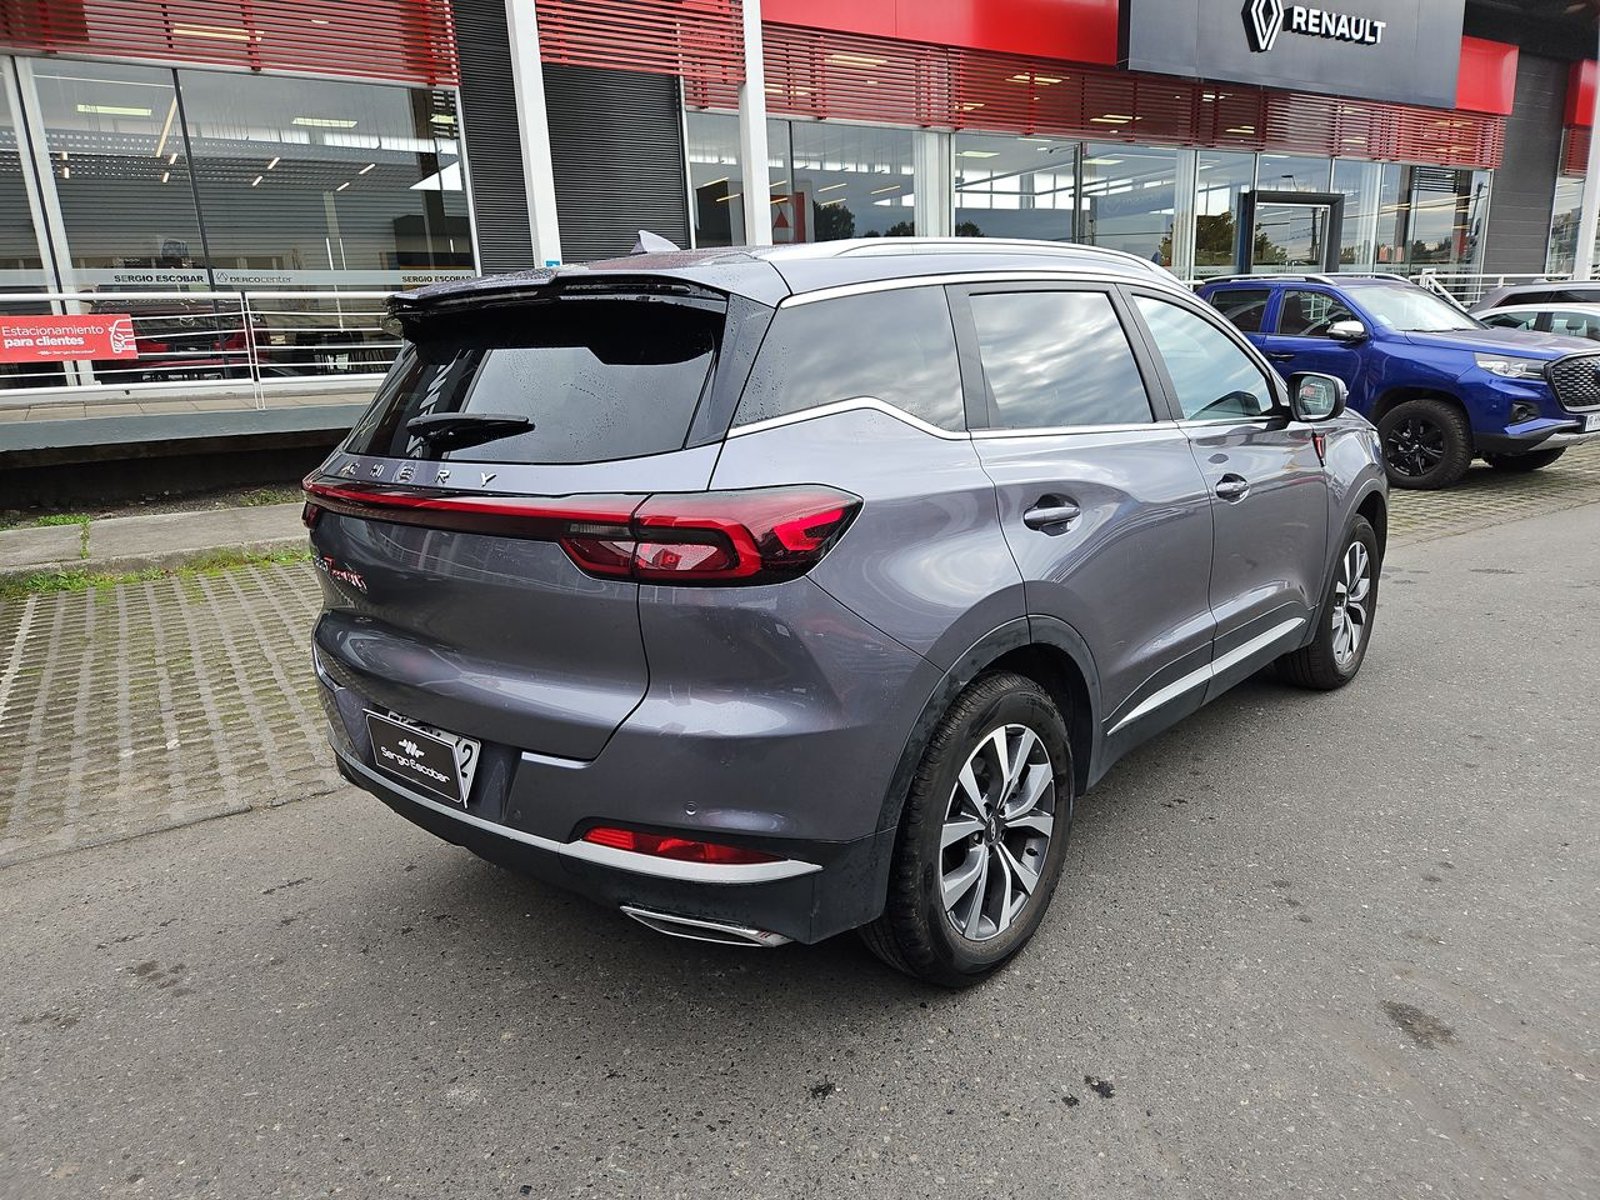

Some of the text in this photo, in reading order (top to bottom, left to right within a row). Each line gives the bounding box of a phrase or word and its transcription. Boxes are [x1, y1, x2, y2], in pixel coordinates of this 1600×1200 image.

[1292, 5, 1387, 44] RENAULT
[114, 274, 205, 283] SERGIO ESCOBAR
[402, 274, 433, 283] SERGIO
[1, 325, 104, 337] Estacionamiento
[4, 335, 85, 349] para clientes
[342, 462, 498, 488] CHERY
